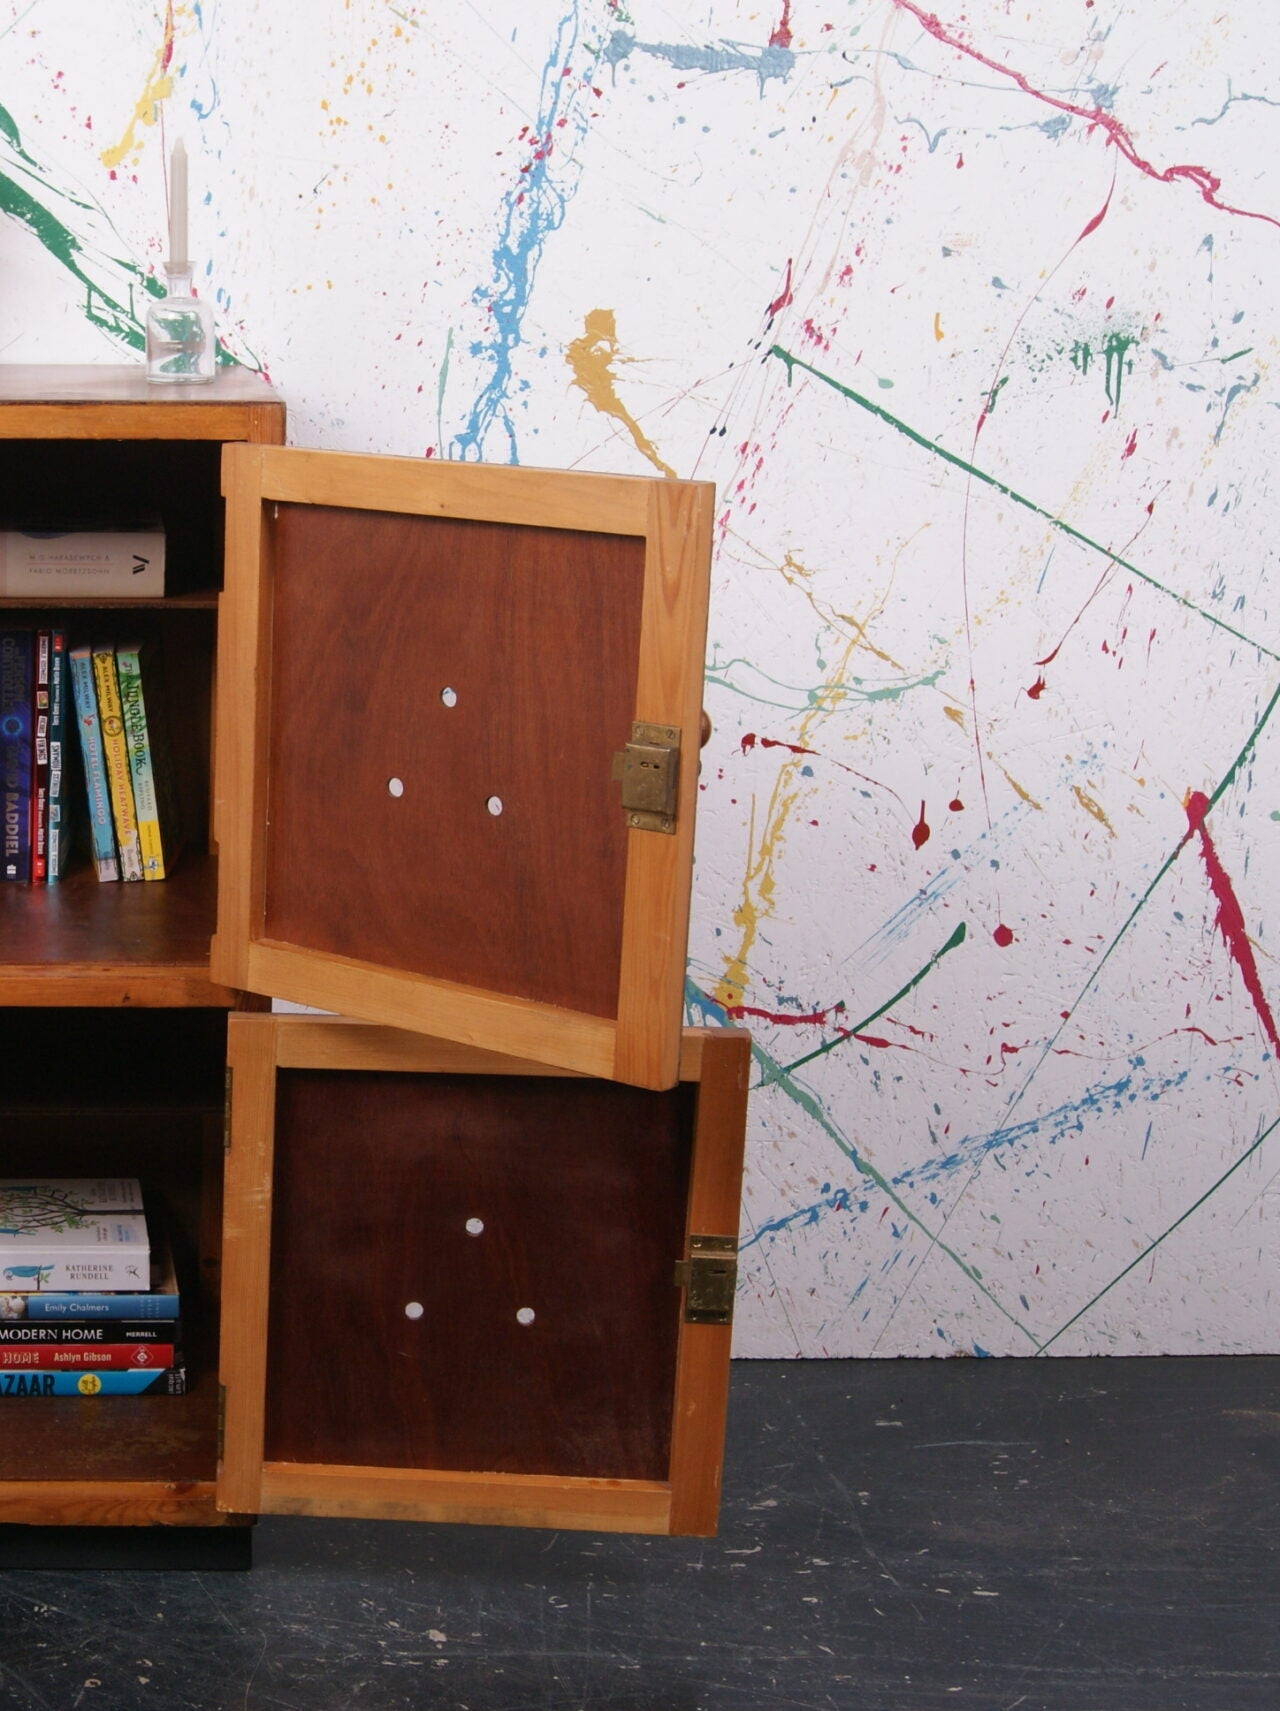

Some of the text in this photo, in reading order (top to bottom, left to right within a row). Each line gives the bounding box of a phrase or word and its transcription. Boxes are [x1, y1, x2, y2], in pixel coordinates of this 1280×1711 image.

[104, 685, 114, 713] MILWAY
[126, 682, 143, 731] JUNGLE
[112, 739, 124, 781] HOLIDAY
[132, 733, 147, 775] BOOK
[87, 737, 107, 825] HOTEL FLAMINGO
[117, 784, 131, 836] HEATWAVE
[5, 793, 20, 857] BADDIEL
[65, 1264, 114, 1272] KATHERINE
[70, 1272, 109, 1280] RUNDELL
[45, 1303, 110, 1314] Emily Chalmers
[62, 1328, 104, 1341] HOME
[3, 1351, 40, 1365] HOME
[54, 1351, 112, 1363] Ashlyn Gibson
